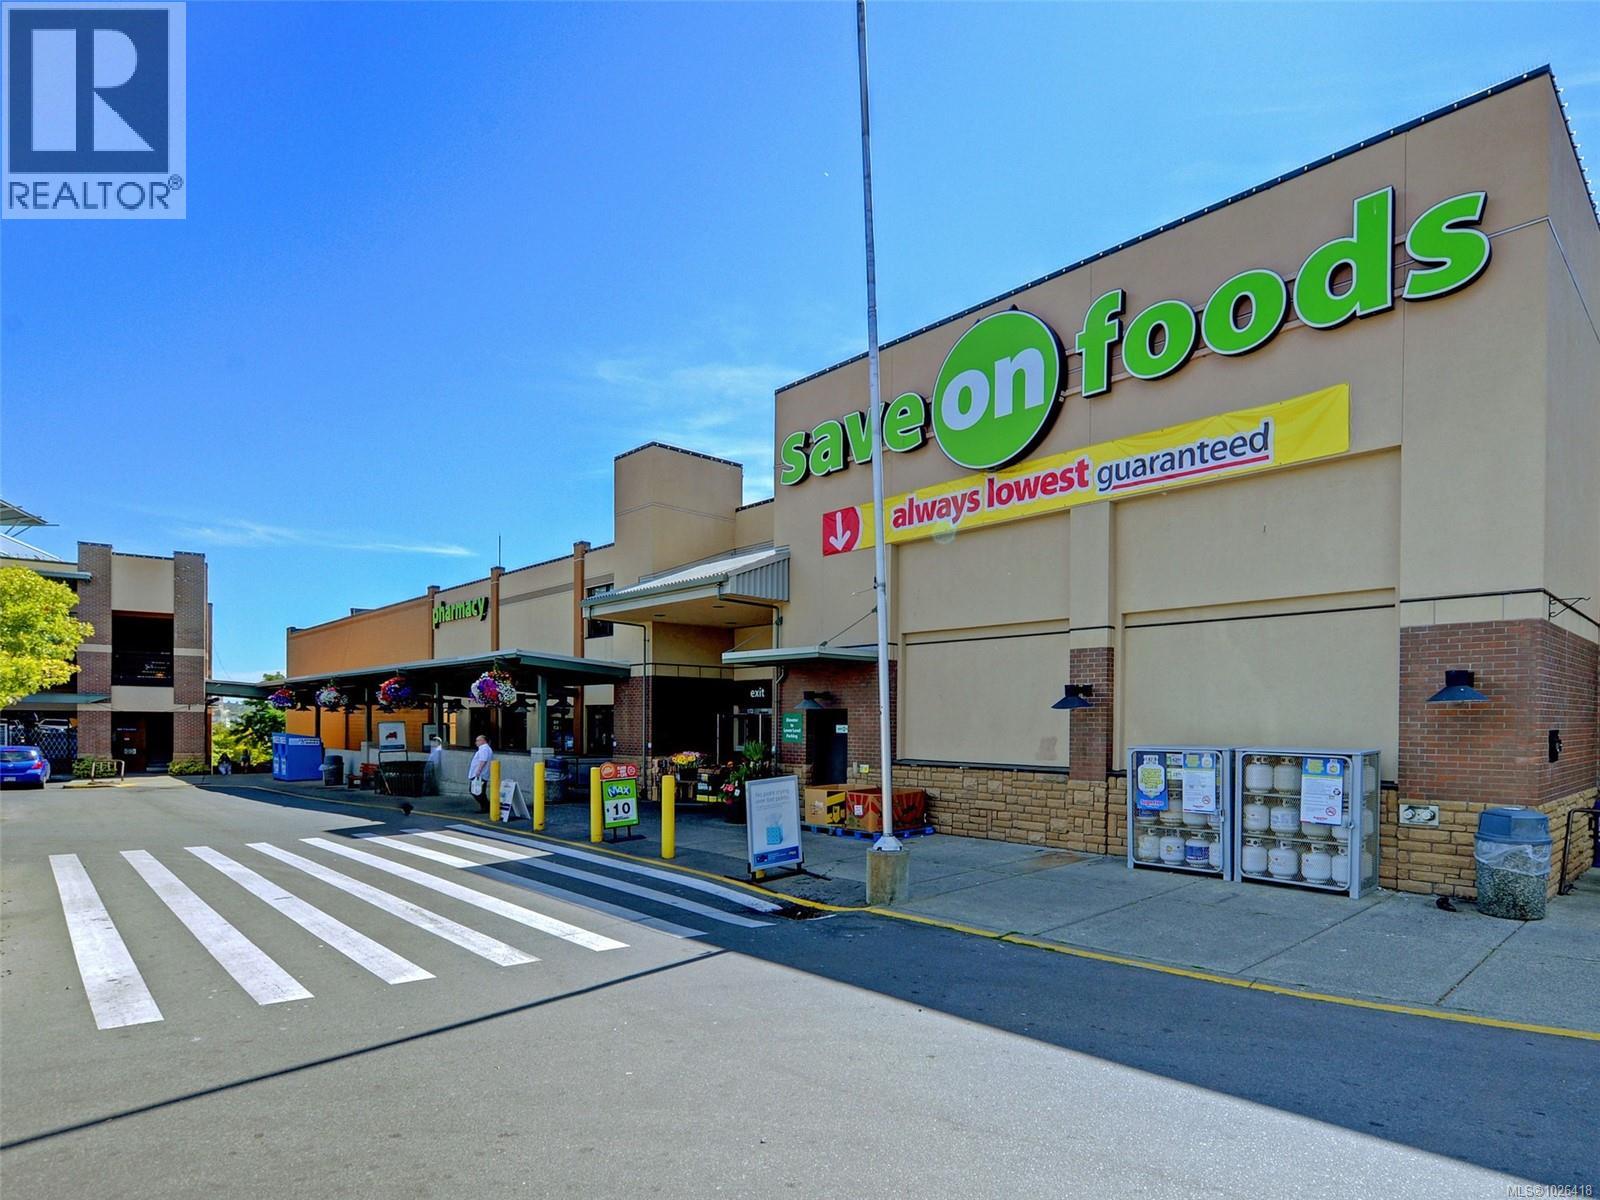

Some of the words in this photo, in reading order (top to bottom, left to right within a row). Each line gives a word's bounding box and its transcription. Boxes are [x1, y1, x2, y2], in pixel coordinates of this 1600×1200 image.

[780, 392, 927, 486] save
[941, 346, 1046, 432] on
[1076, 186, 1492, 397] foods
[892, 489, 980, 528] always
[986, 457, 1090, 508] lowest
[1096, 421, 1271, 492] guaranteed
[432, 596, 487, 630] pharmacy
[750, 687, 765, 698] exit
